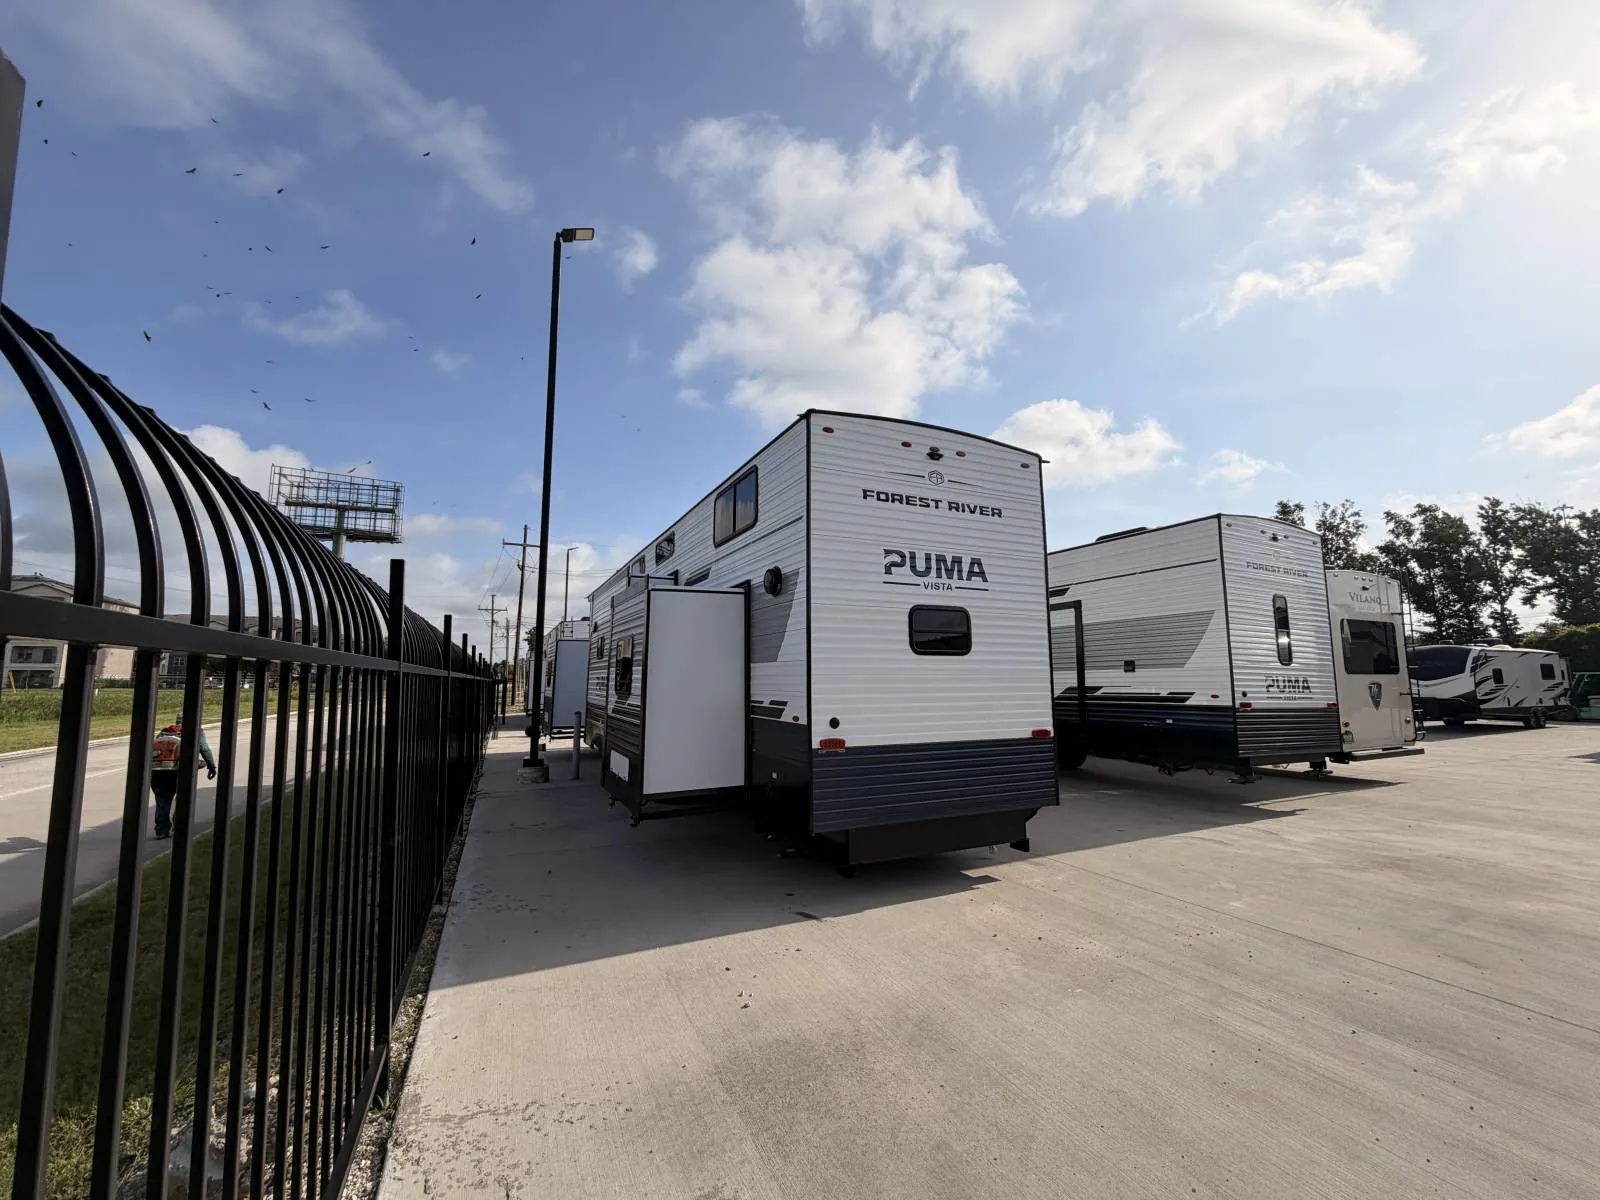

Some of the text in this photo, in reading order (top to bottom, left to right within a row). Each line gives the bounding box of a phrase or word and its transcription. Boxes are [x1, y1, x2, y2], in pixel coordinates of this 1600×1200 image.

[861, 488, 1003, 519] FOREST RIVER
[882, 548, 989, 583] PUMA
[1246, 560, 1281, 575] FOREST
[922, 581, 953, 592] VISTA
[1264, 675, 1313, 694] PUMA
